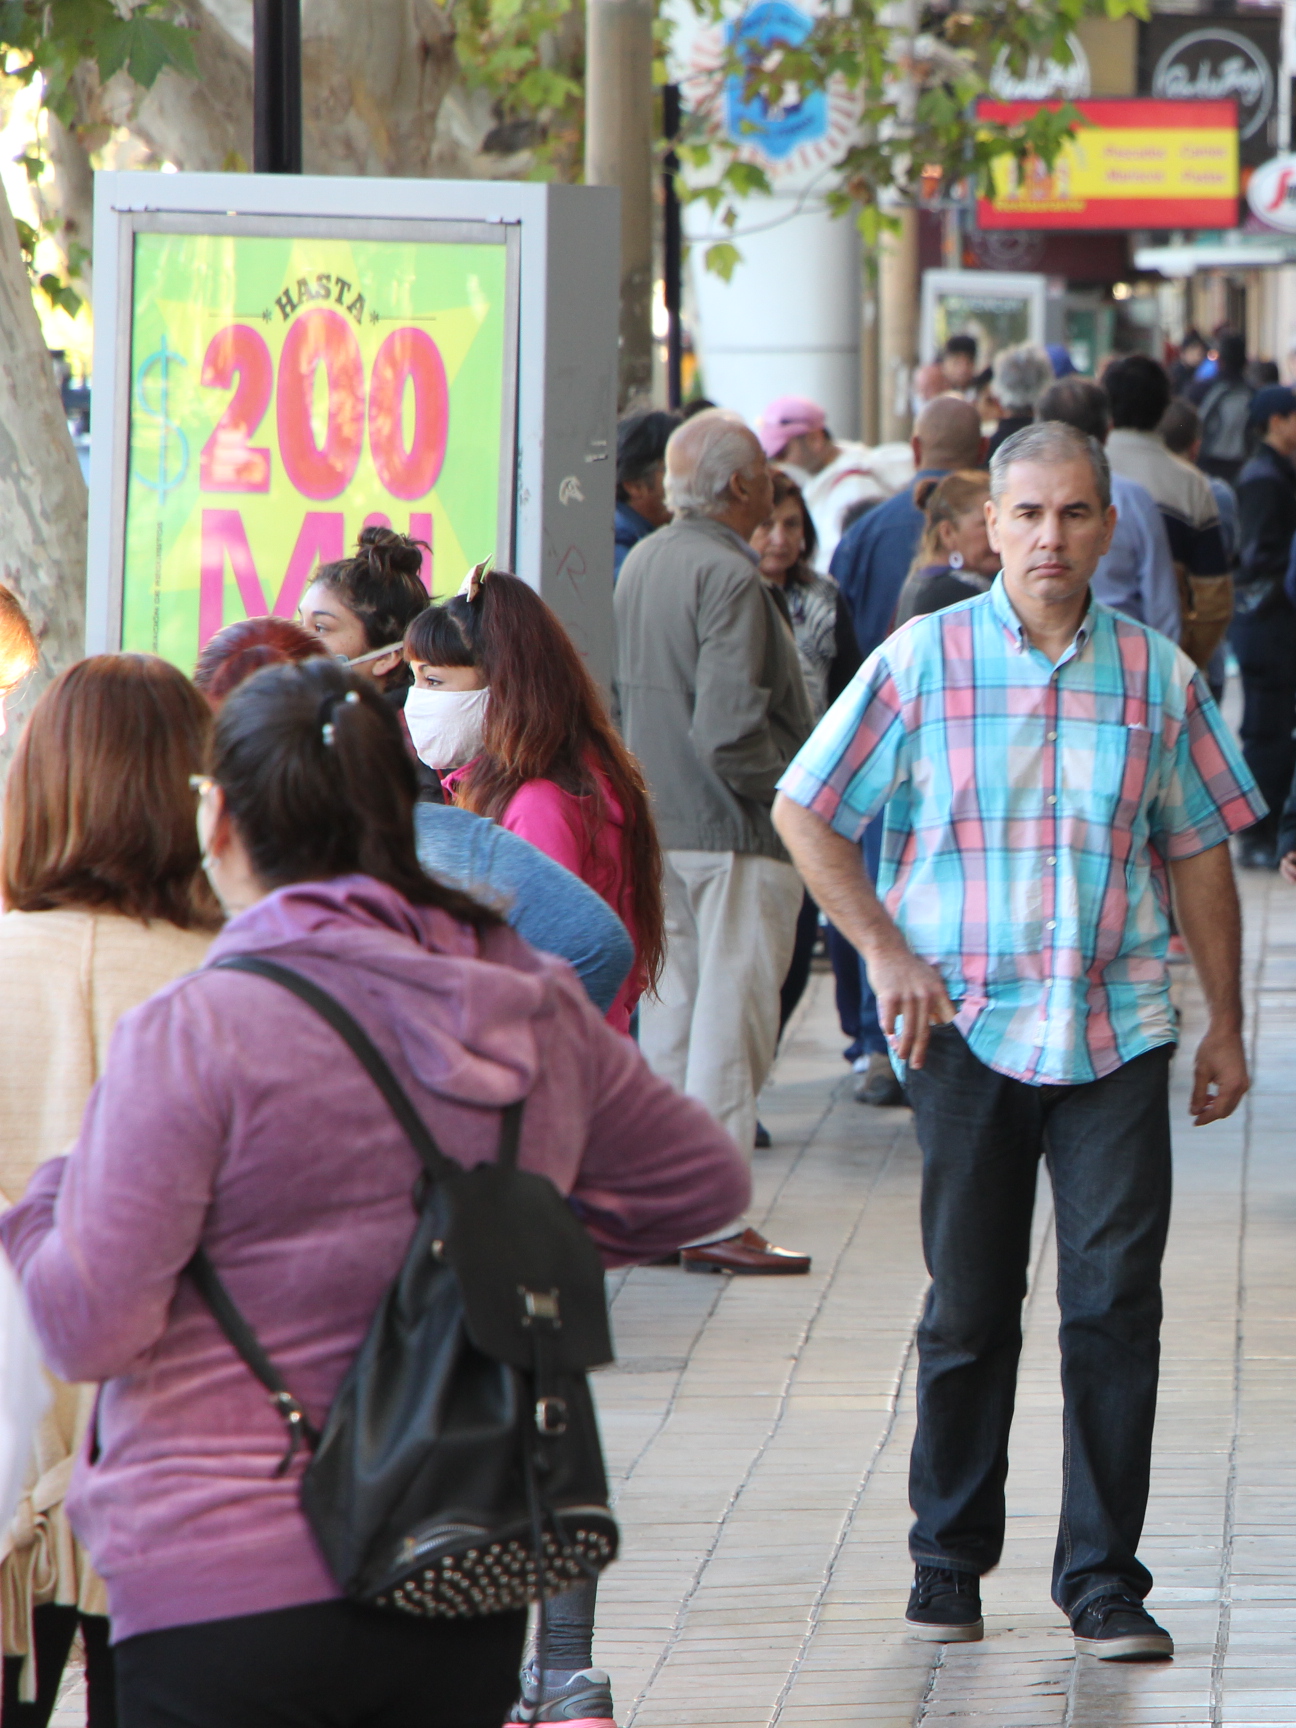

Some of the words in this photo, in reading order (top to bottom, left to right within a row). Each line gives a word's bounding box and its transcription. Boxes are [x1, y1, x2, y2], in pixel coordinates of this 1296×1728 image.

[275, 273, 366, 325] HASTA
[134, 333, 189, 505] $
[200, 307, 449, 500] 200
